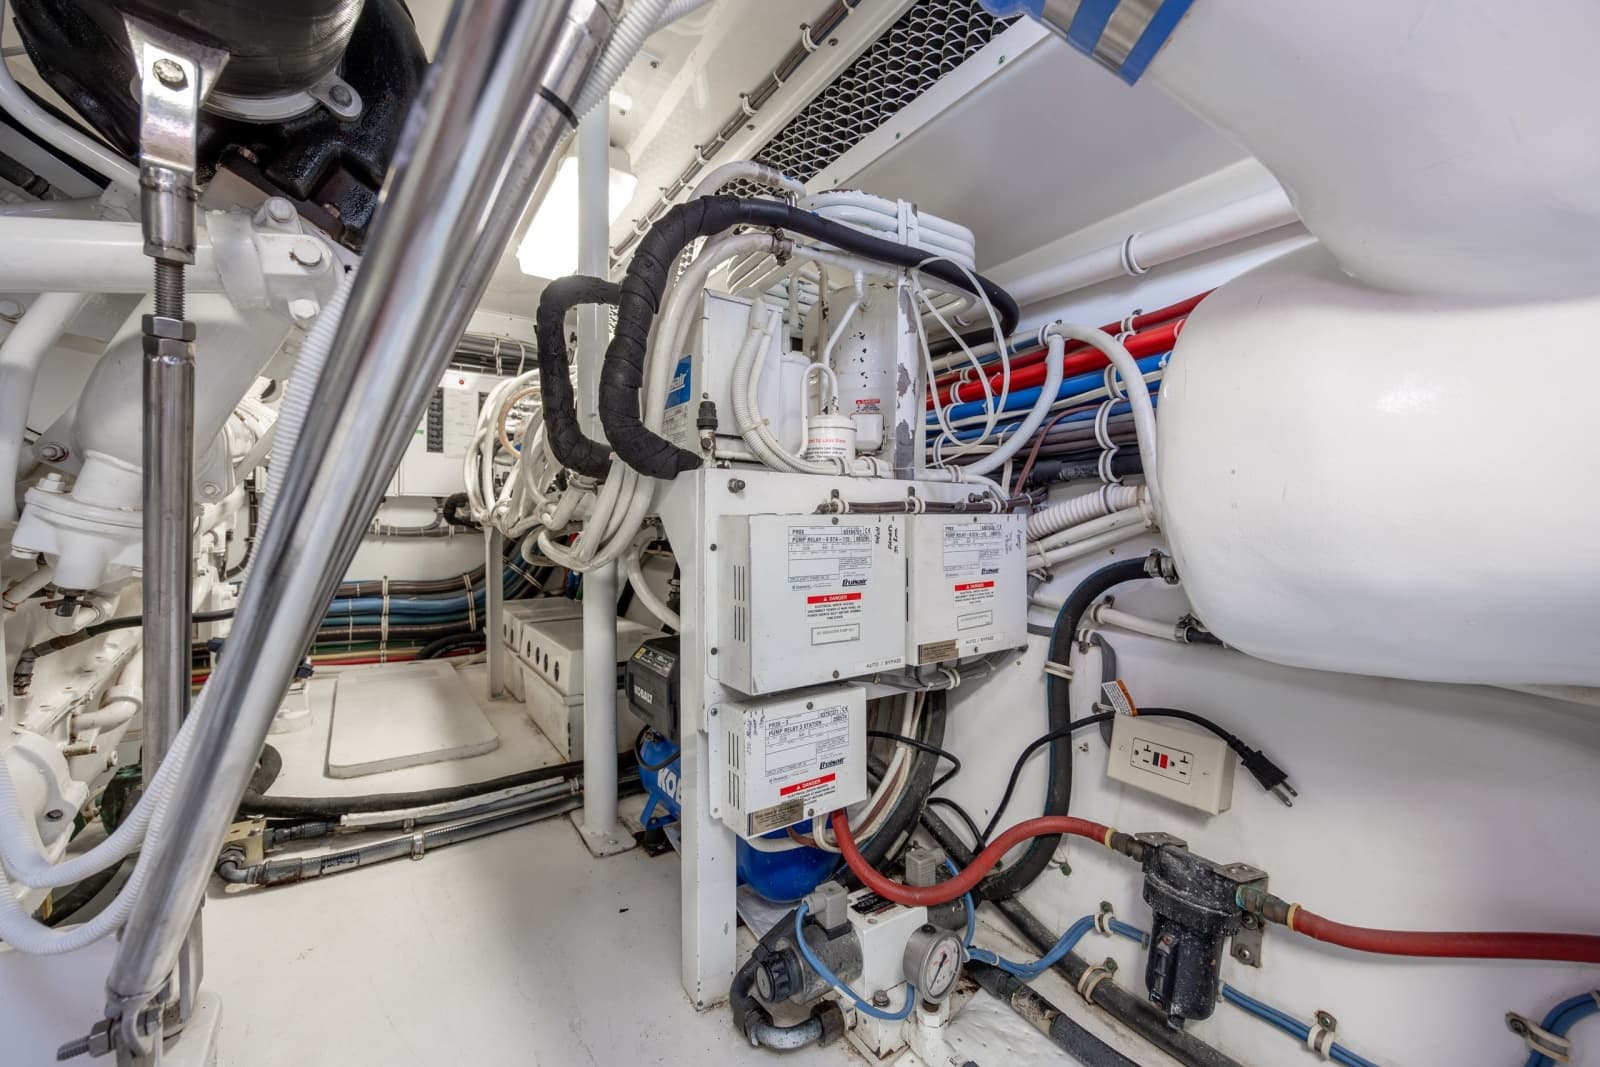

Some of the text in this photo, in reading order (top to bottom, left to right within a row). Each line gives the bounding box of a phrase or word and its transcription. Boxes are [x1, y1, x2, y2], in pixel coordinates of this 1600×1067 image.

[634, 684, 652, 704] KOBALT
[769, 728, 783, 736] PUMP
[784, 725, 798, 733] RELAY
[804, 720, 822, 729] STATION
